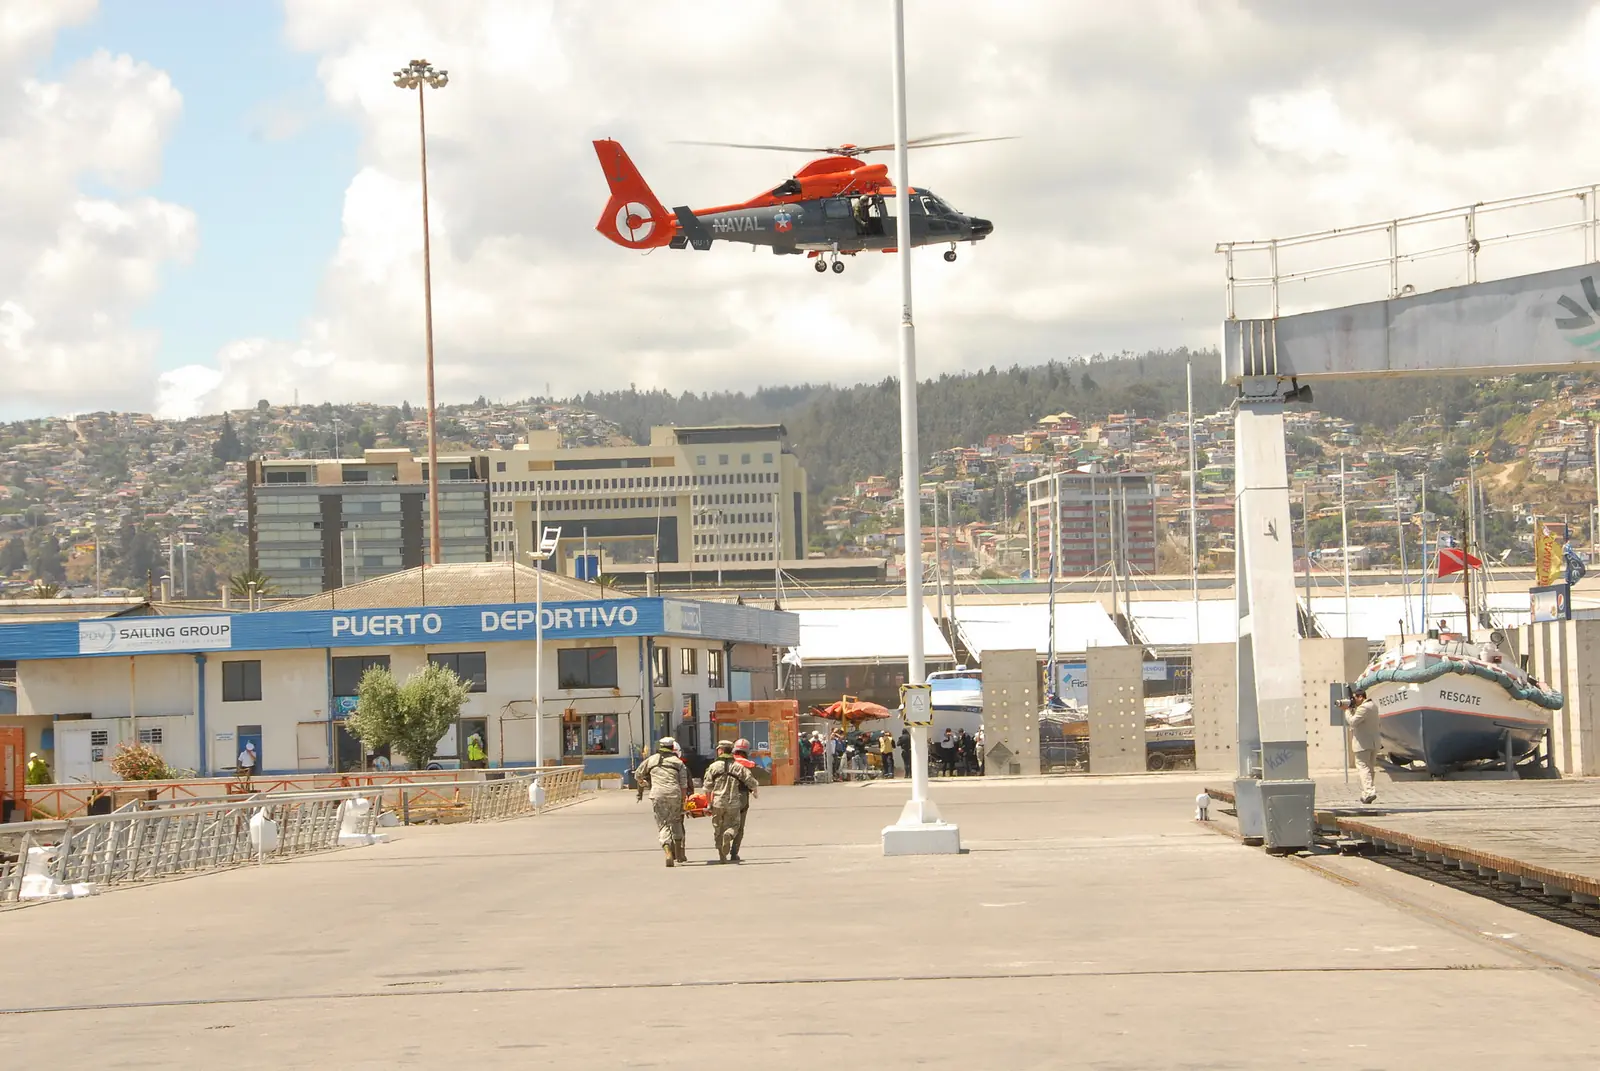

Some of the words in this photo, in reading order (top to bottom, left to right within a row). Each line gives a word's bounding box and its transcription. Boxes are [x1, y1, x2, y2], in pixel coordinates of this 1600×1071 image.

[713, 216, 766, 233] NAVAL
[332, 613, 442, 638] PUERTO
[481, 605, 638, 633] DEPORTIVO
[119, 627, 175, 640] SAILING
[179, 625, 230, 638] GROUP
[1379, 691, 1409, 706] RESCATE
[1439, 690, 1482, 706] RESCATE
